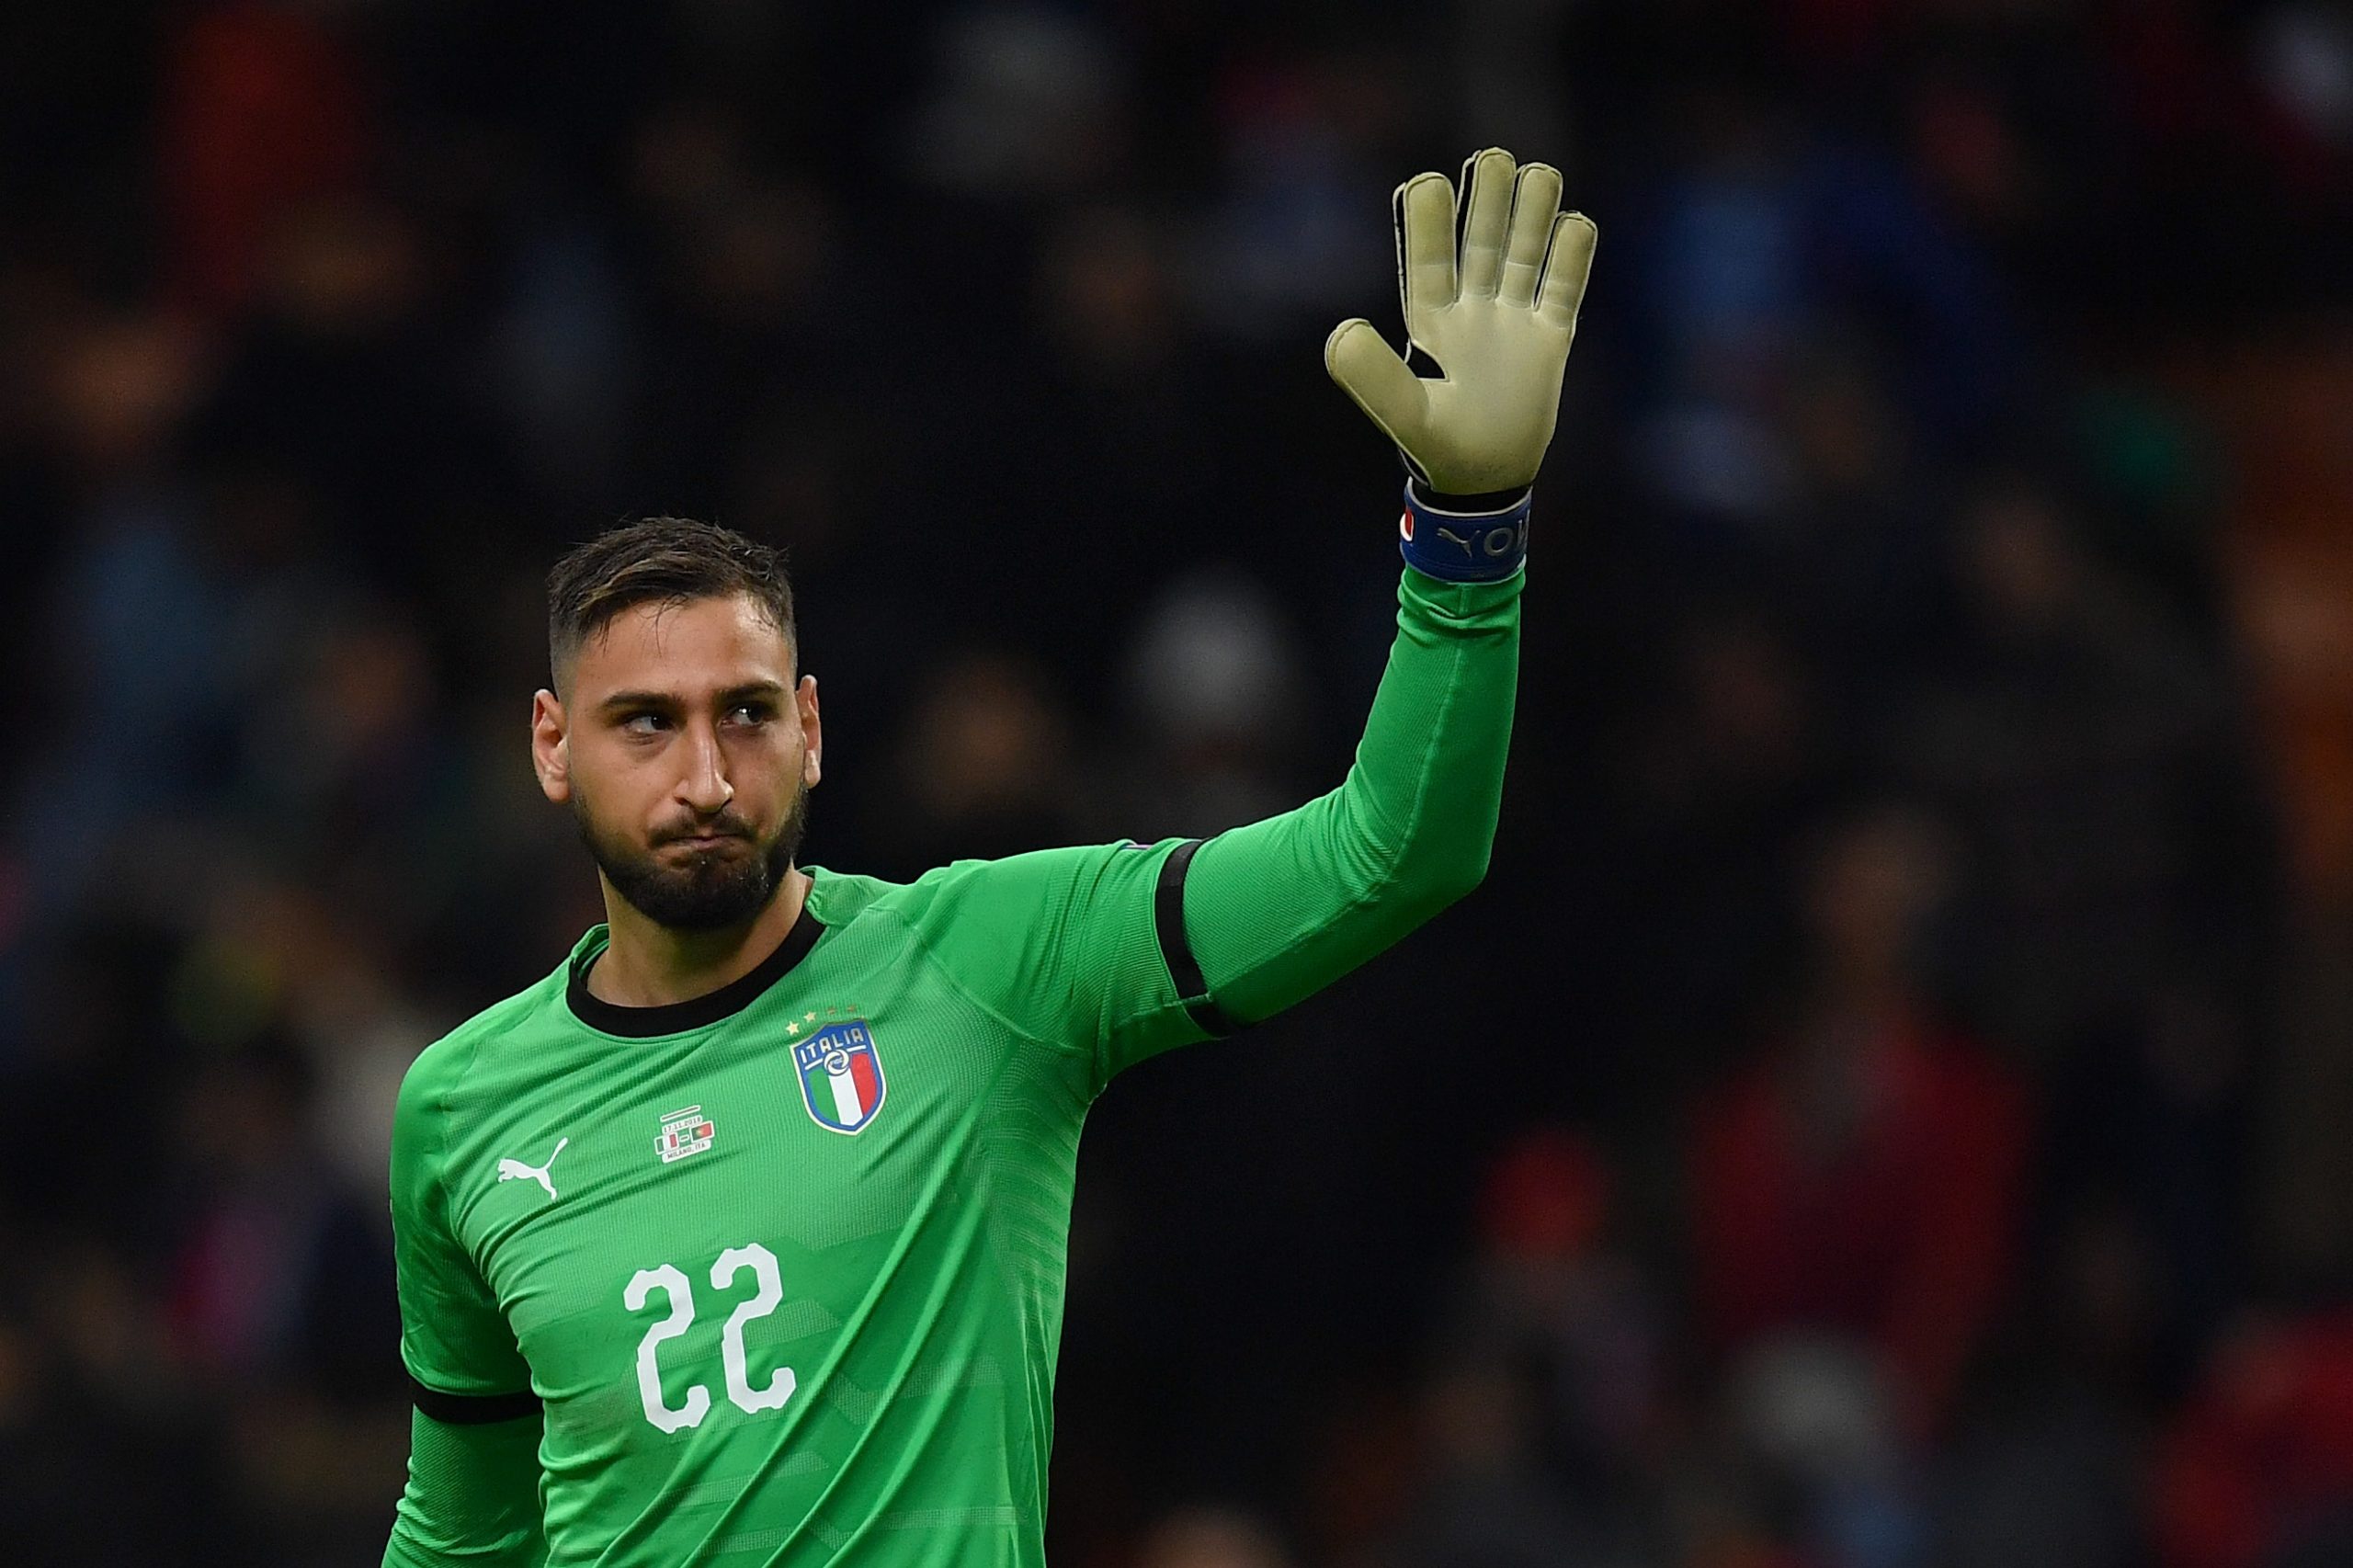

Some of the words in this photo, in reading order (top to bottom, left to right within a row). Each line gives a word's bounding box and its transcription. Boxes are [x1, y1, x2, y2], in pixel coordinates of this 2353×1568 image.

[800, 1028, 864, 1063] ITALIA
[664, 1117, 700, 1133] 17.11.2018
[695, 1142, 706, 1150] ITA
[623, 1243, 796, 1434] 22
